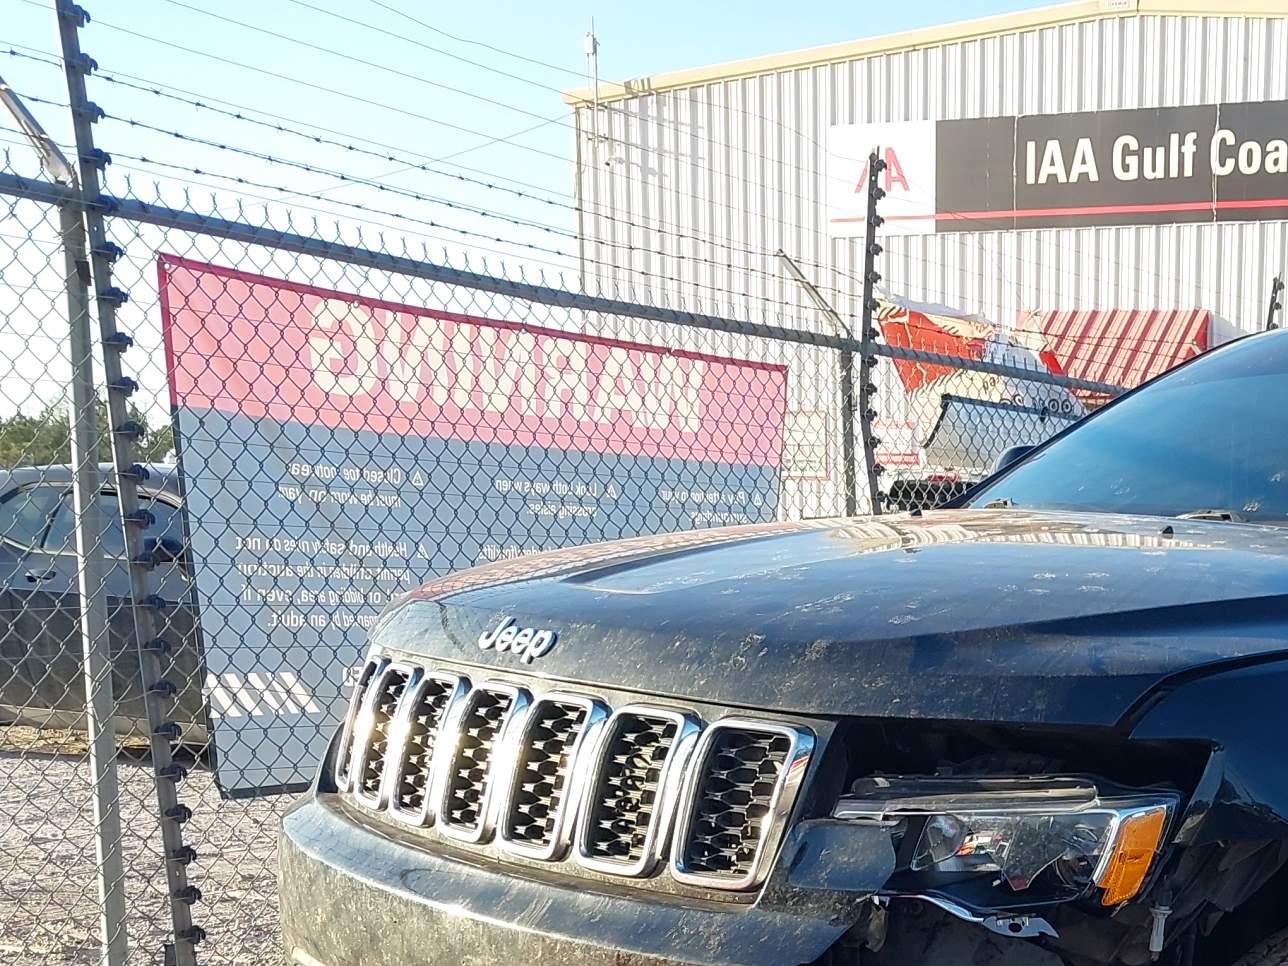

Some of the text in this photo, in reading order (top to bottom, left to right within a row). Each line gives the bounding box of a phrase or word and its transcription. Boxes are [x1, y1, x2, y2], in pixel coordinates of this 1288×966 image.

[1025, 137, 1099, 185] IAA
[1111, 130, 1199, 181] Gulf
[478, 615, 557, 664] Jeep
